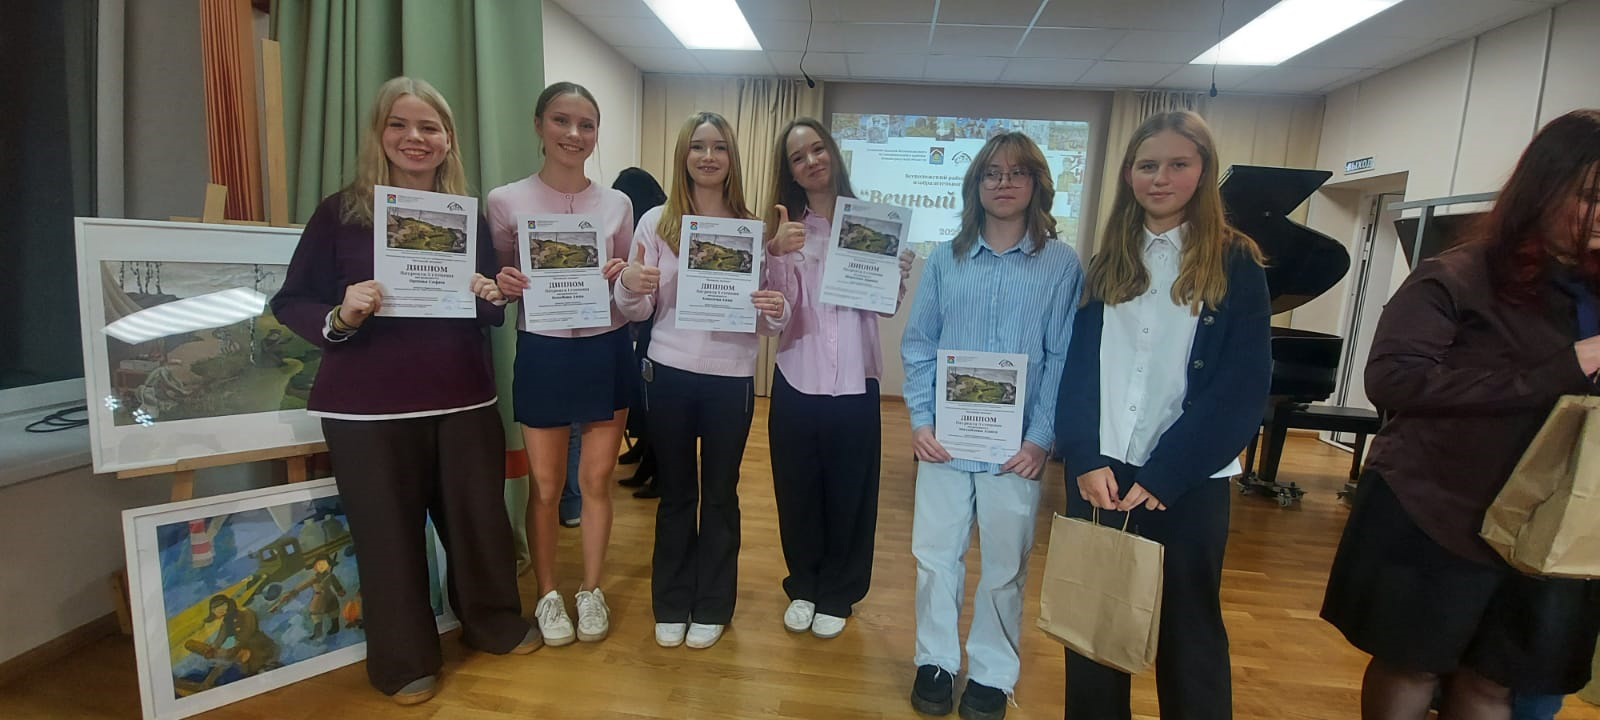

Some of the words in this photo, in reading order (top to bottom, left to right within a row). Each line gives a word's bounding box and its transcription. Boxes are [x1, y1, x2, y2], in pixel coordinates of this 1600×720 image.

[1346, 159, 1374, 171] ВЫХОД
[406, 263, 448, 273] ДИПЛОМ
[847, 260, 880, 272] ДИПЛОМ
[549, 280, 585, 289] ДИПЛОМ
[700, 282, 735, 291] ДИПЛОМ
[960, 415, 997, 423] ДИПЛОМ
